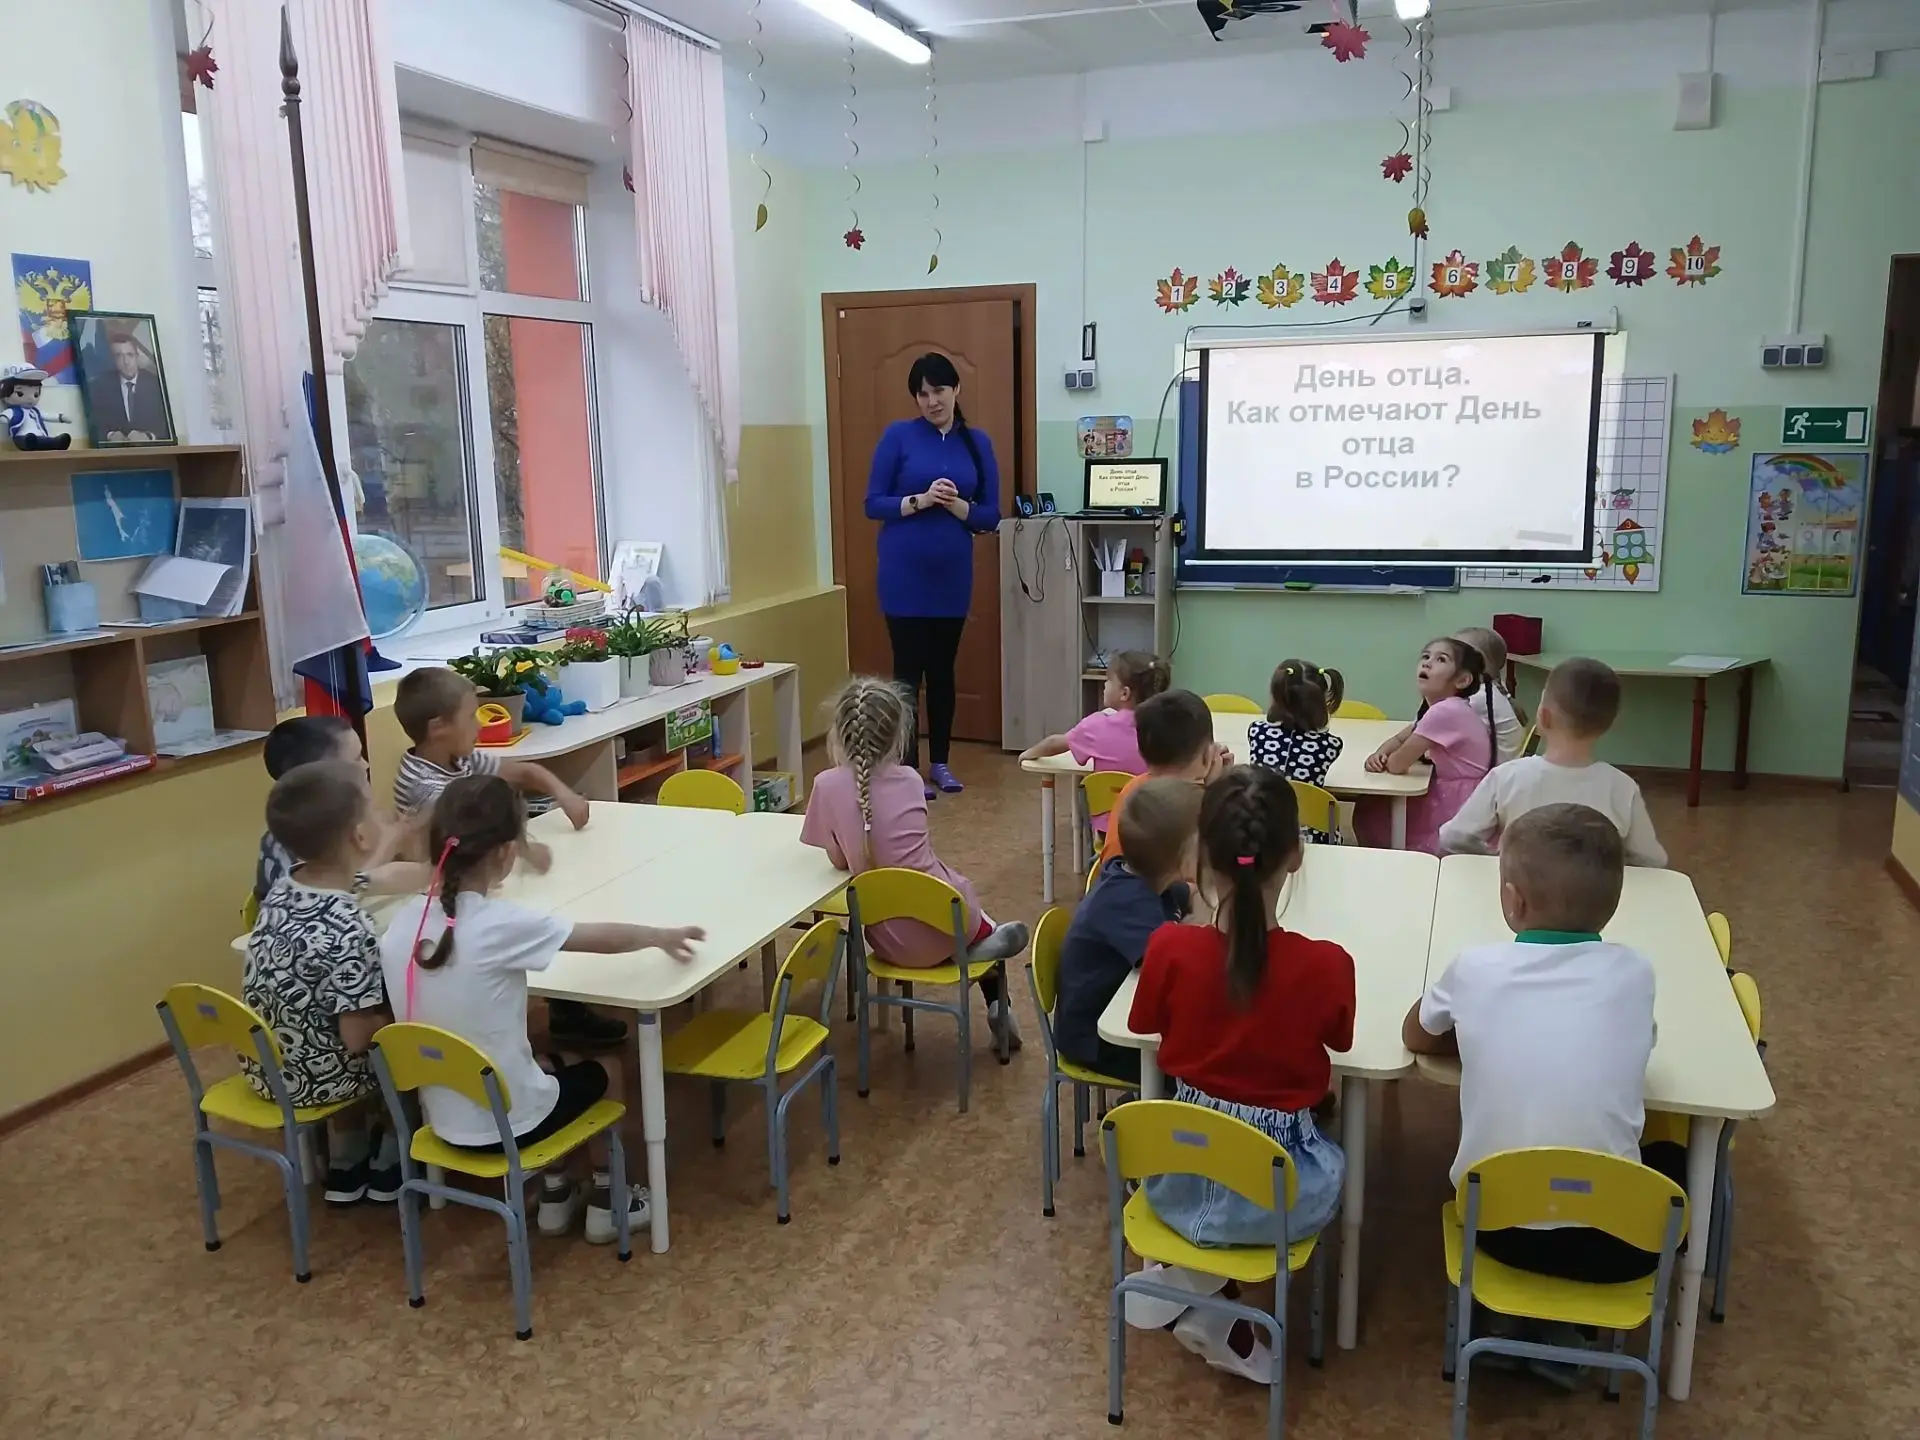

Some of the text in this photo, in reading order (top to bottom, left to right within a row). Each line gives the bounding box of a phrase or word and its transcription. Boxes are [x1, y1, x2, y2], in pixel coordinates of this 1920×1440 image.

[1564, 263, 1574, 278] 8
[1625, 259, 1635, 274] 9
[1687, 257, 1704, 270] 10
[1448, 269, 1458, 284] 6
[1507, 266, 1516, 279] 7
[1224, 282, 1233, 296] 2
[1275, 281, 1285, 295] 3
[1329, 279, 1339, 291] 4
[1385, 274, 1395, 289] 5
[1174, 288, 1180, 301] 1
[1294, 364, 1470, 393] День отца.
[1228, 395, 1541, 424] Как отмечают День
[1342, 436, 1415, 458] отца
[1296, 464, 1460, 488] в России?
